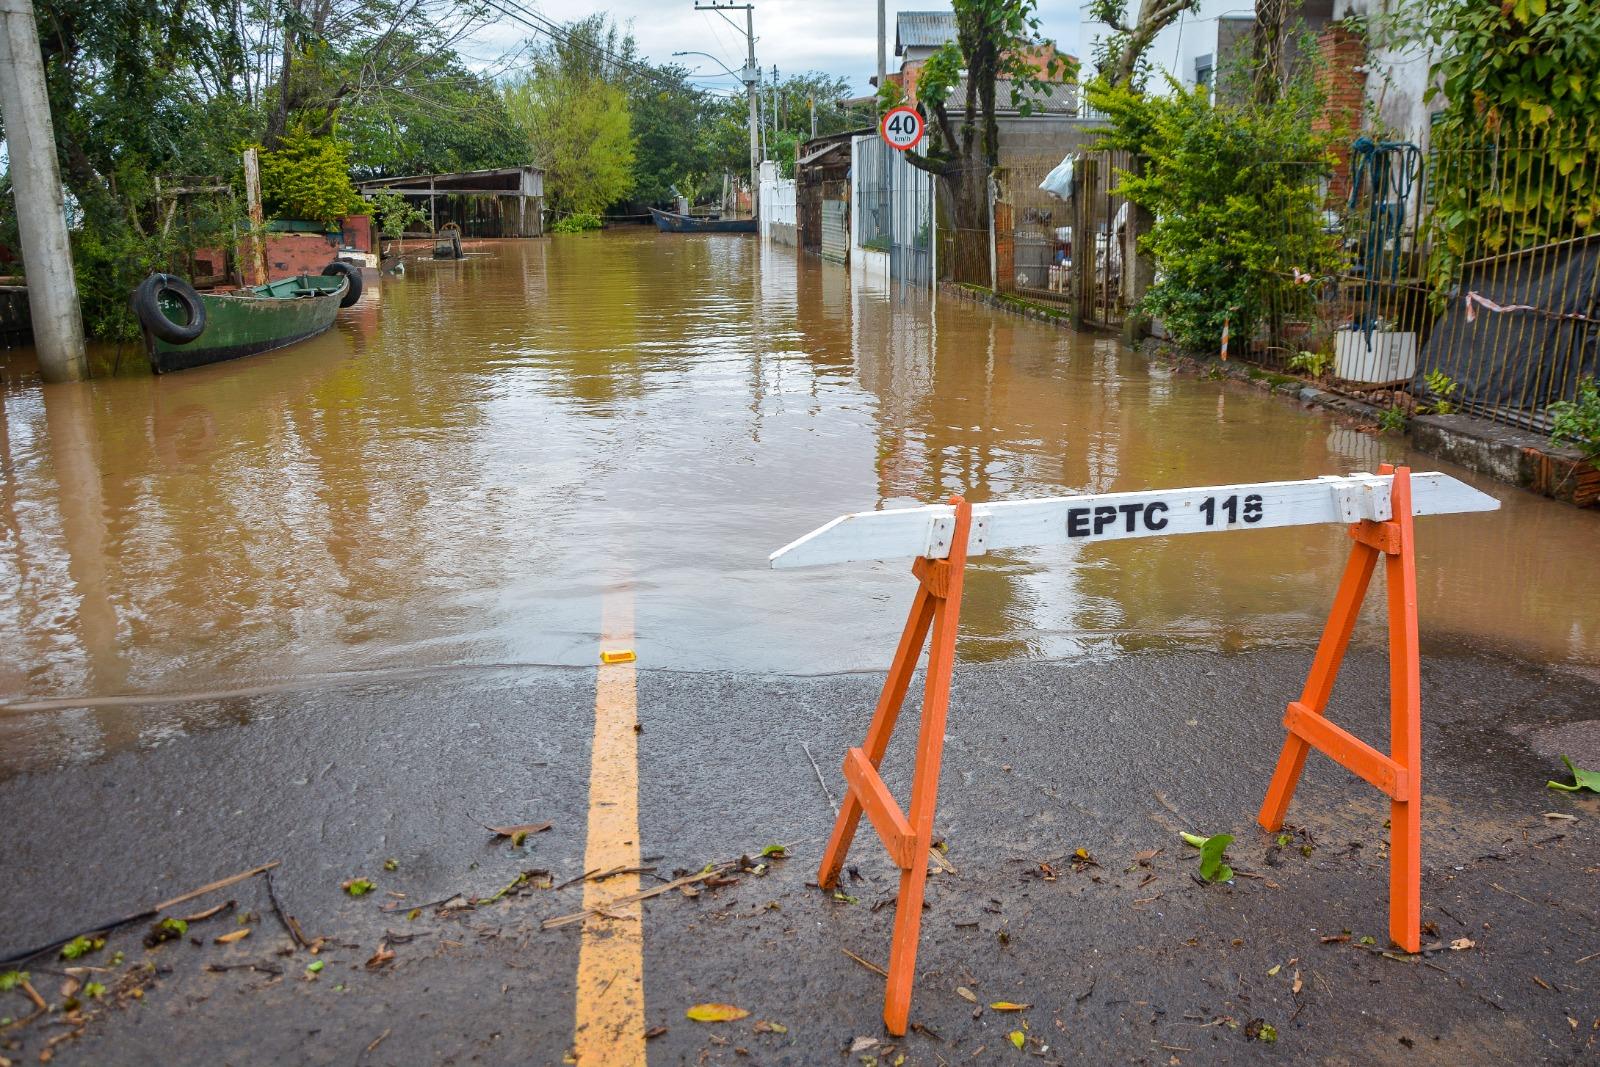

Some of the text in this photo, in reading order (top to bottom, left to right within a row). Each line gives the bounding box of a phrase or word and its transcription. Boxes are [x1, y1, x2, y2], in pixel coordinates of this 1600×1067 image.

[888, 115, 916, 134] 40
[1067, 494, 1263, 537] EPTC 118
